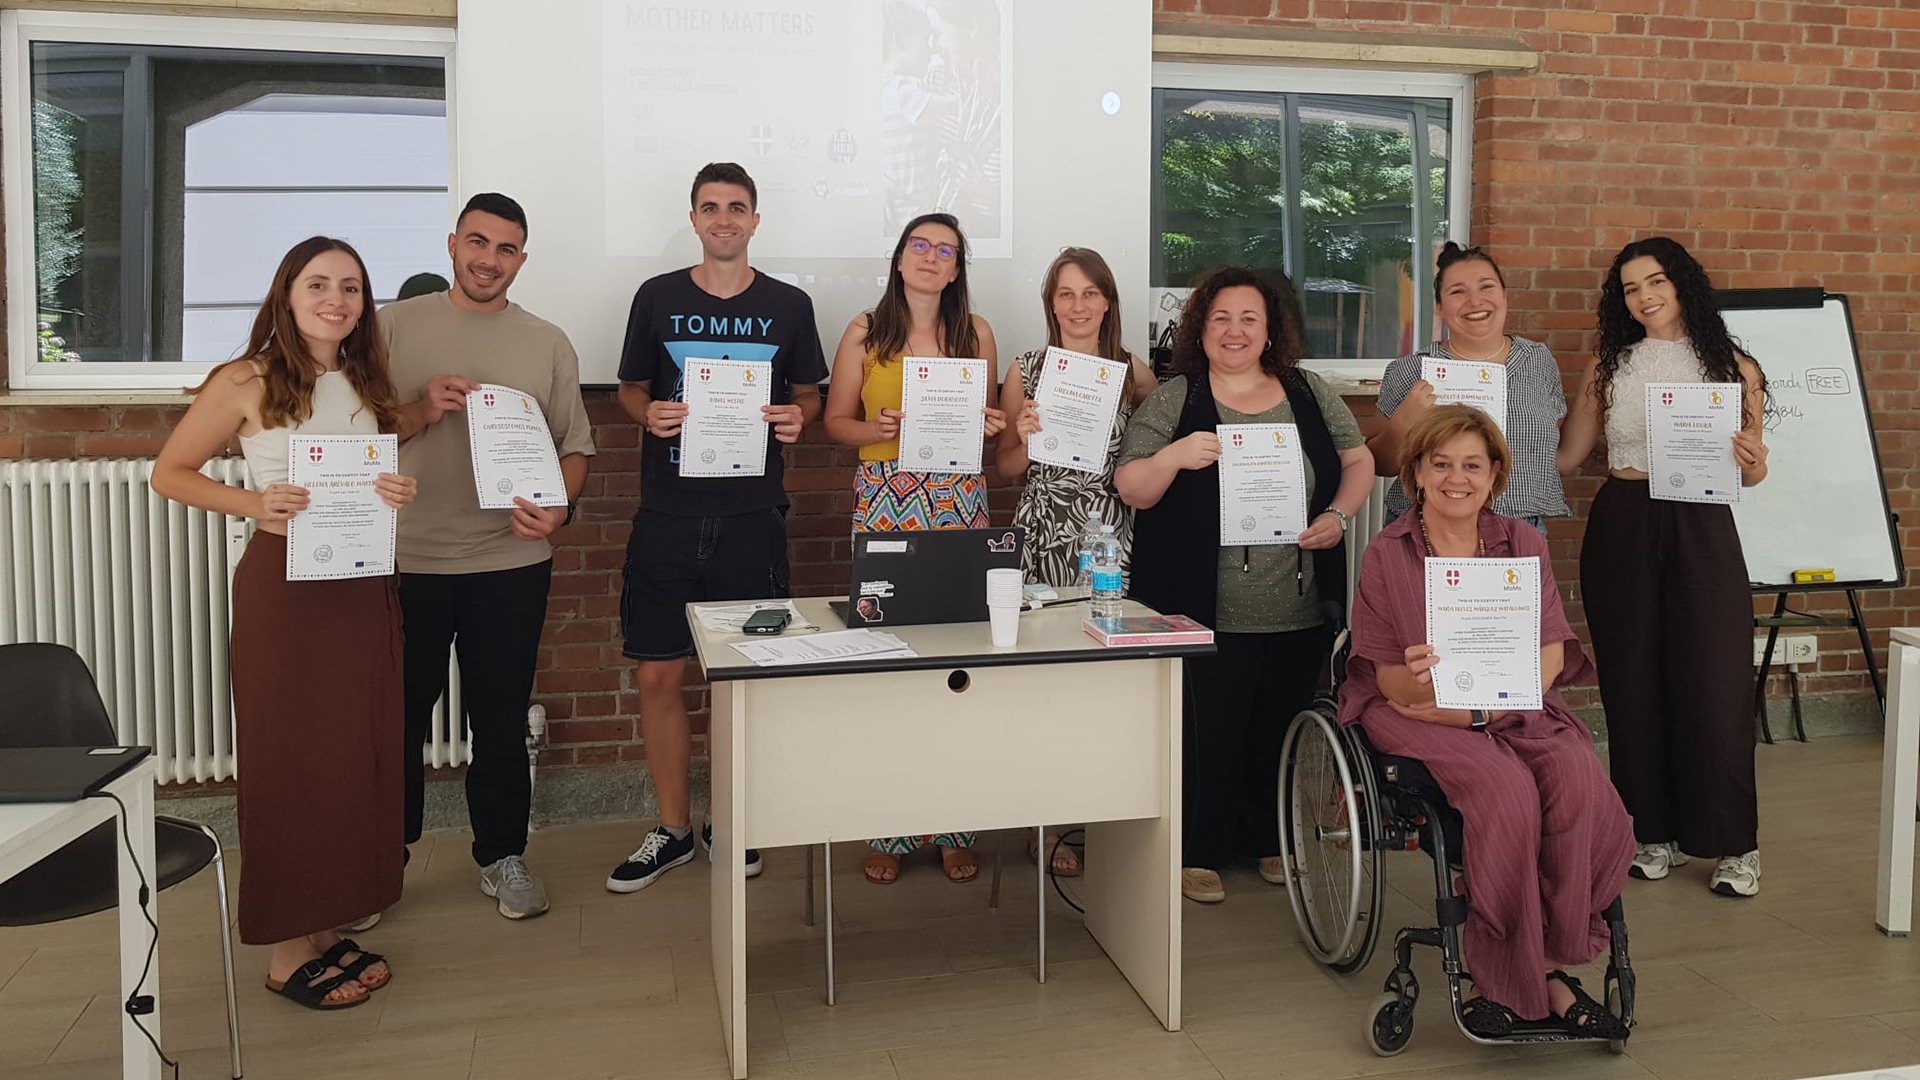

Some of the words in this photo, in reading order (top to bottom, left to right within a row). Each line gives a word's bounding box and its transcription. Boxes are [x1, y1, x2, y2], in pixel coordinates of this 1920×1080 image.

[626, 4, 713, 33] MOTHER
[721, 10, 815, 36] MATTERS
[834, 132, 852, 142] LET
[834, 143, 853, 153] HER
[670, 315, 773, 337] TOMMY
[1808, 374, 1843, 389] FREE
